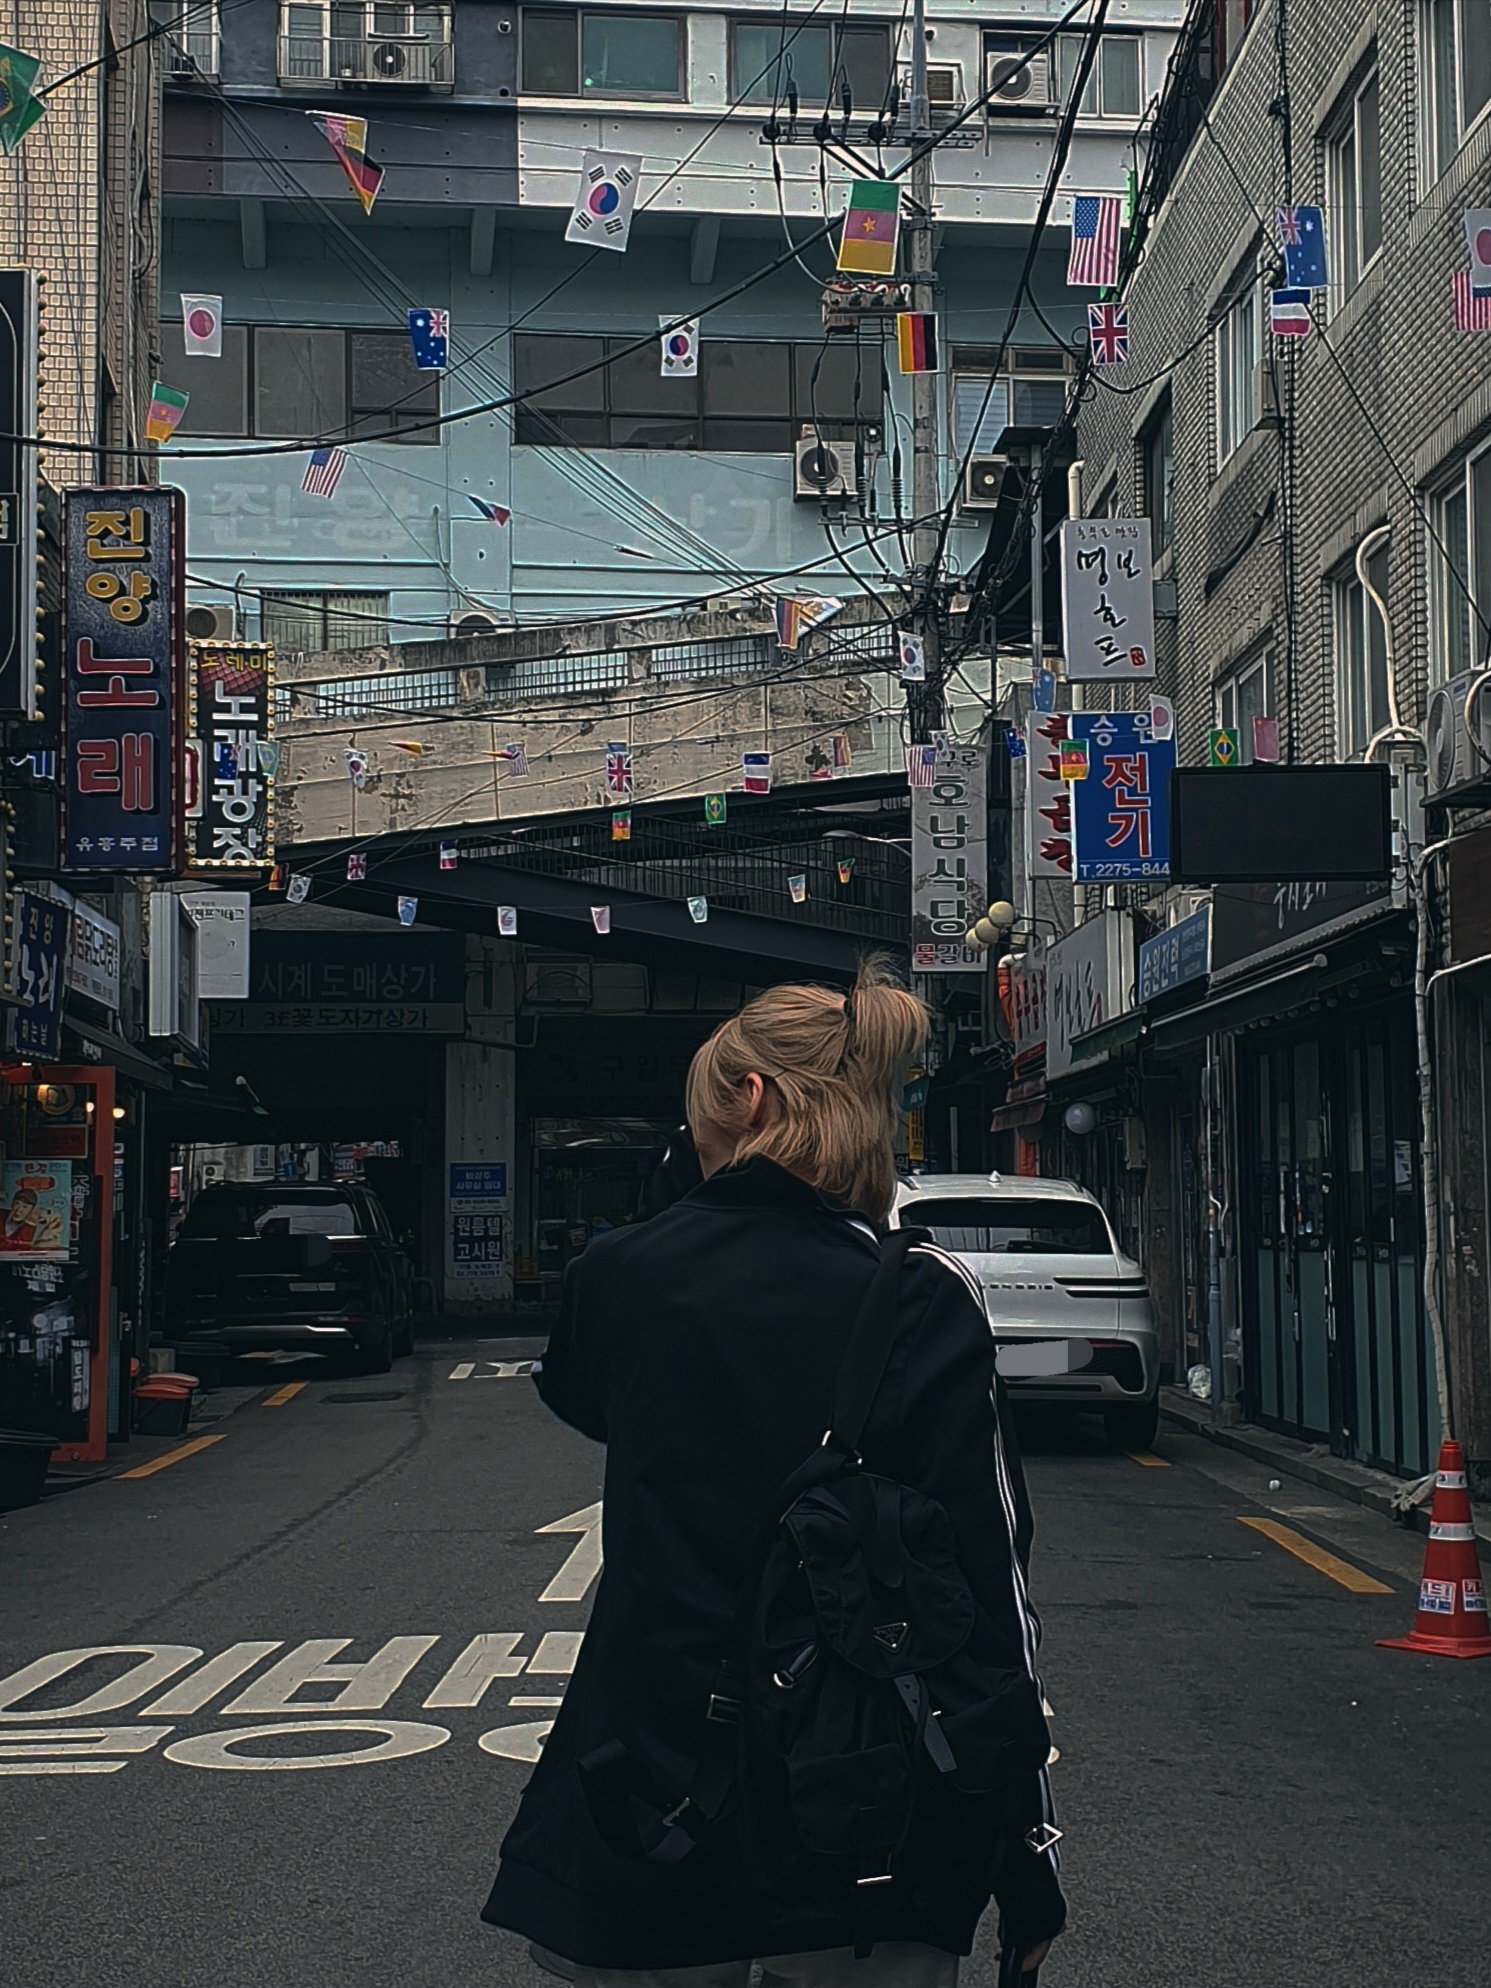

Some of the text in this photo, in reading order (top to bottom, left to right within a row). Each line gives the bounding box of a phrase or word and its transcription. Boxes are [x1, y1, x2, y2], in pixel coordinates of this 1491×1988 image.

[86, 507, 152, 622] 진양
[201, 652, 268, 671] 도레미
[76, 636, 159, 812] 노래
[1102, 752, 1152, 858] 전기
[76, 837, 159, 851] 유흥주점
[928, 774, 974, 936] 호남식당
[1080, 862, 1171, 878] T.2275-844
[320, 962, 437, 1000] 도매상가
[456, 1241, 501, 1261] 고시원
